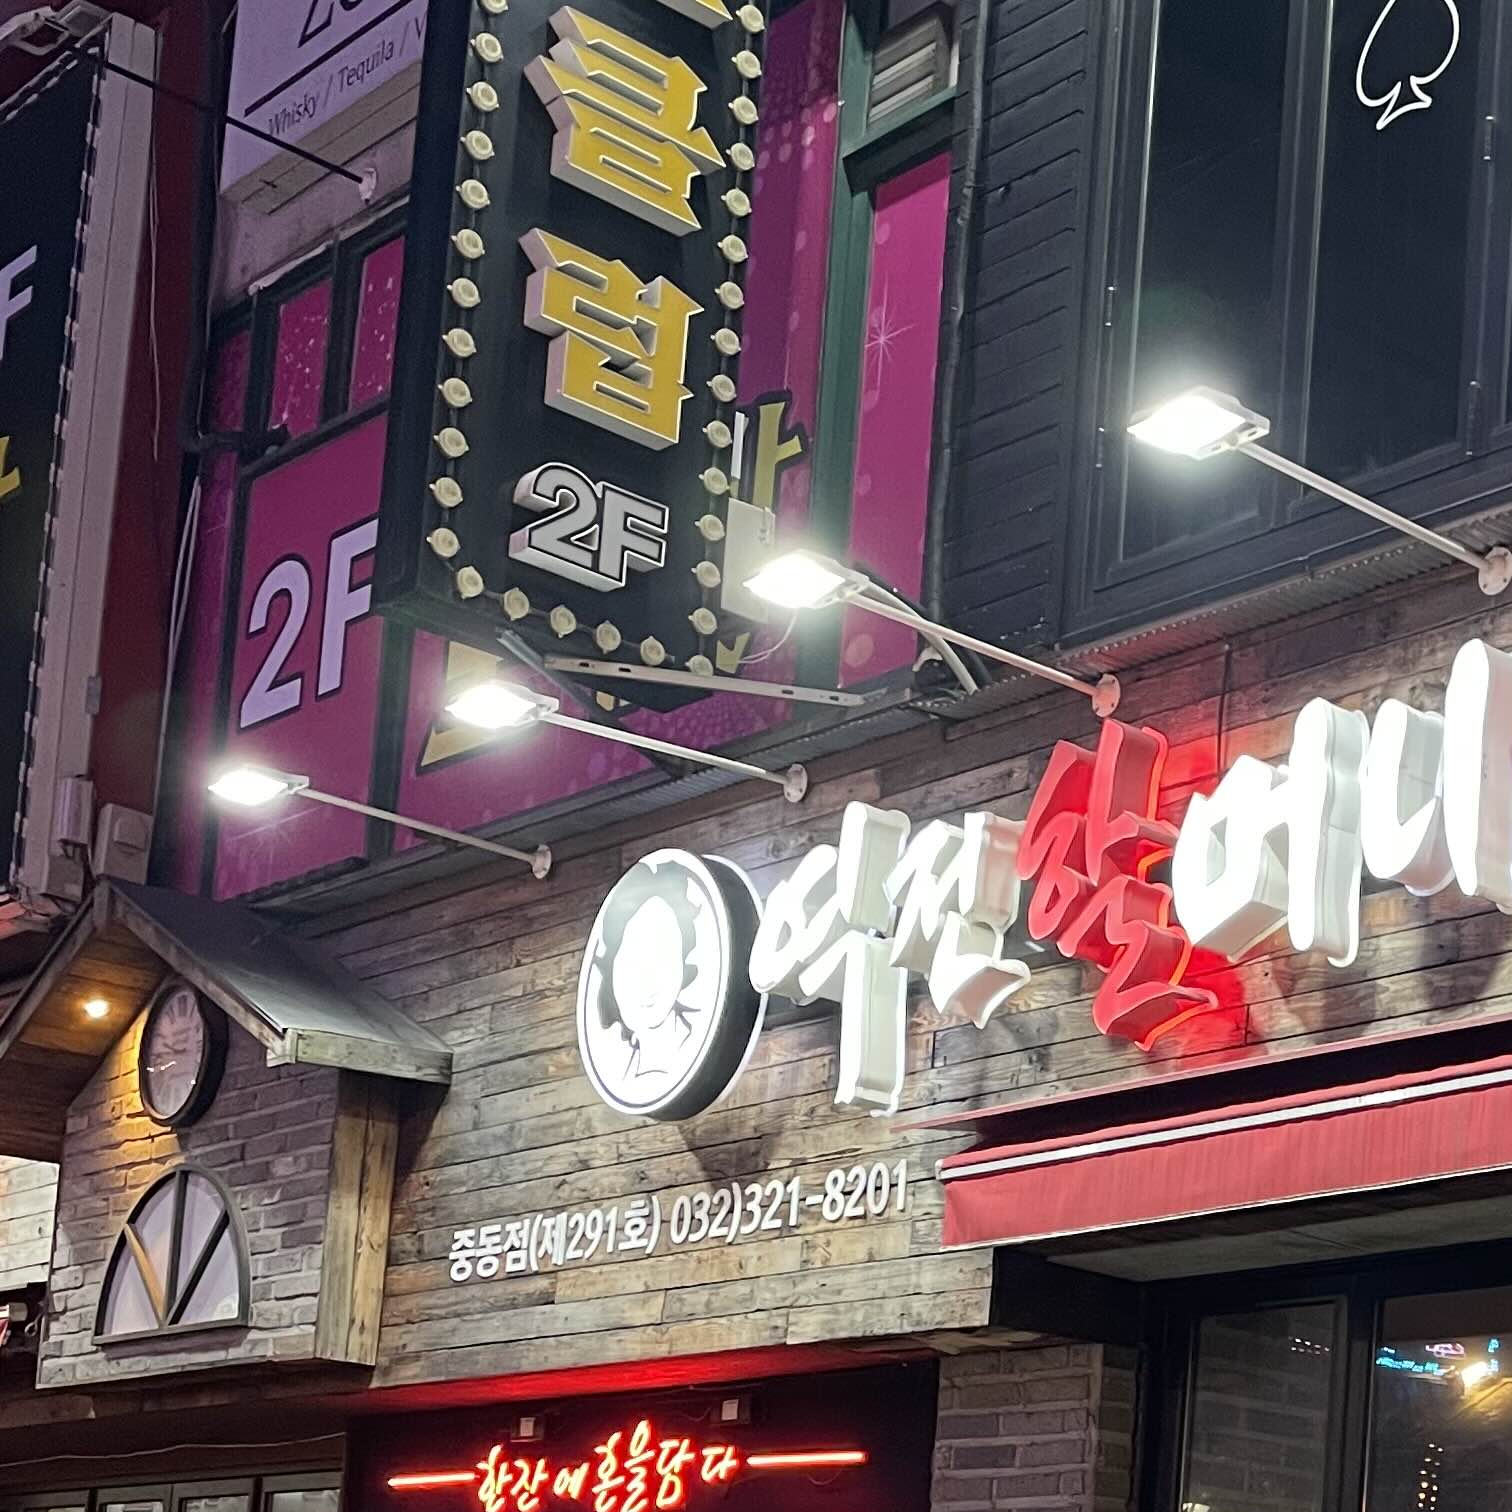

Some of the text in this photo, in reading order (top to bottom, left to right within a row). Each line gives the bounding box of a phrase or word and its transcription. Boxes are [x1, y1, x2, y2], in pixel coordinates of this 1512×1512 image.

[268, 92, 319, 138] Whisky
[337, 40, 396, 92] Tequila
[523, 0, 735, 450] 클럽
[508, 461, 669, 593] 2F
[239, 518, 379, 730] 2F
[670, 1158, 908, 1246] 032)321-8201
